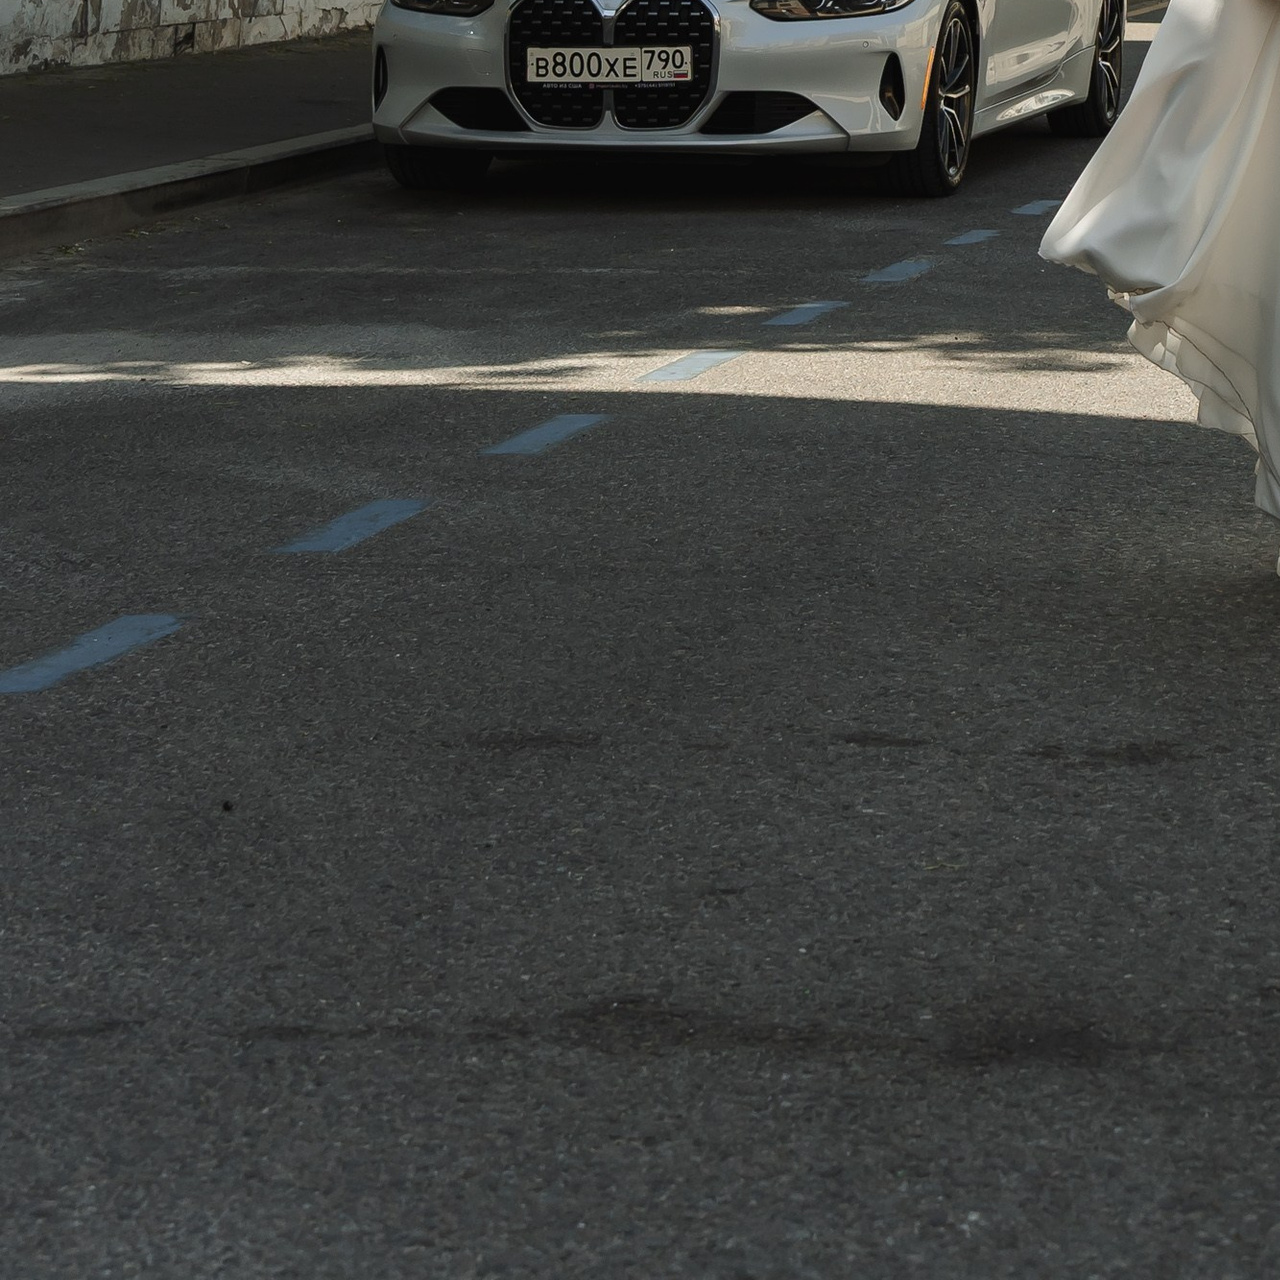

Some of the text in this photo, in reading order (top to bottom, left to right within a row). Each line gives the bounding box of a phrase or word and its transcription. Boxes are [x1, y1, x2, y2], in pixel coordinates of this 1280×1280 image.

[535, 49, 685, 78] В800ХЕ 790
[653, 71, 672, 79] RUS
